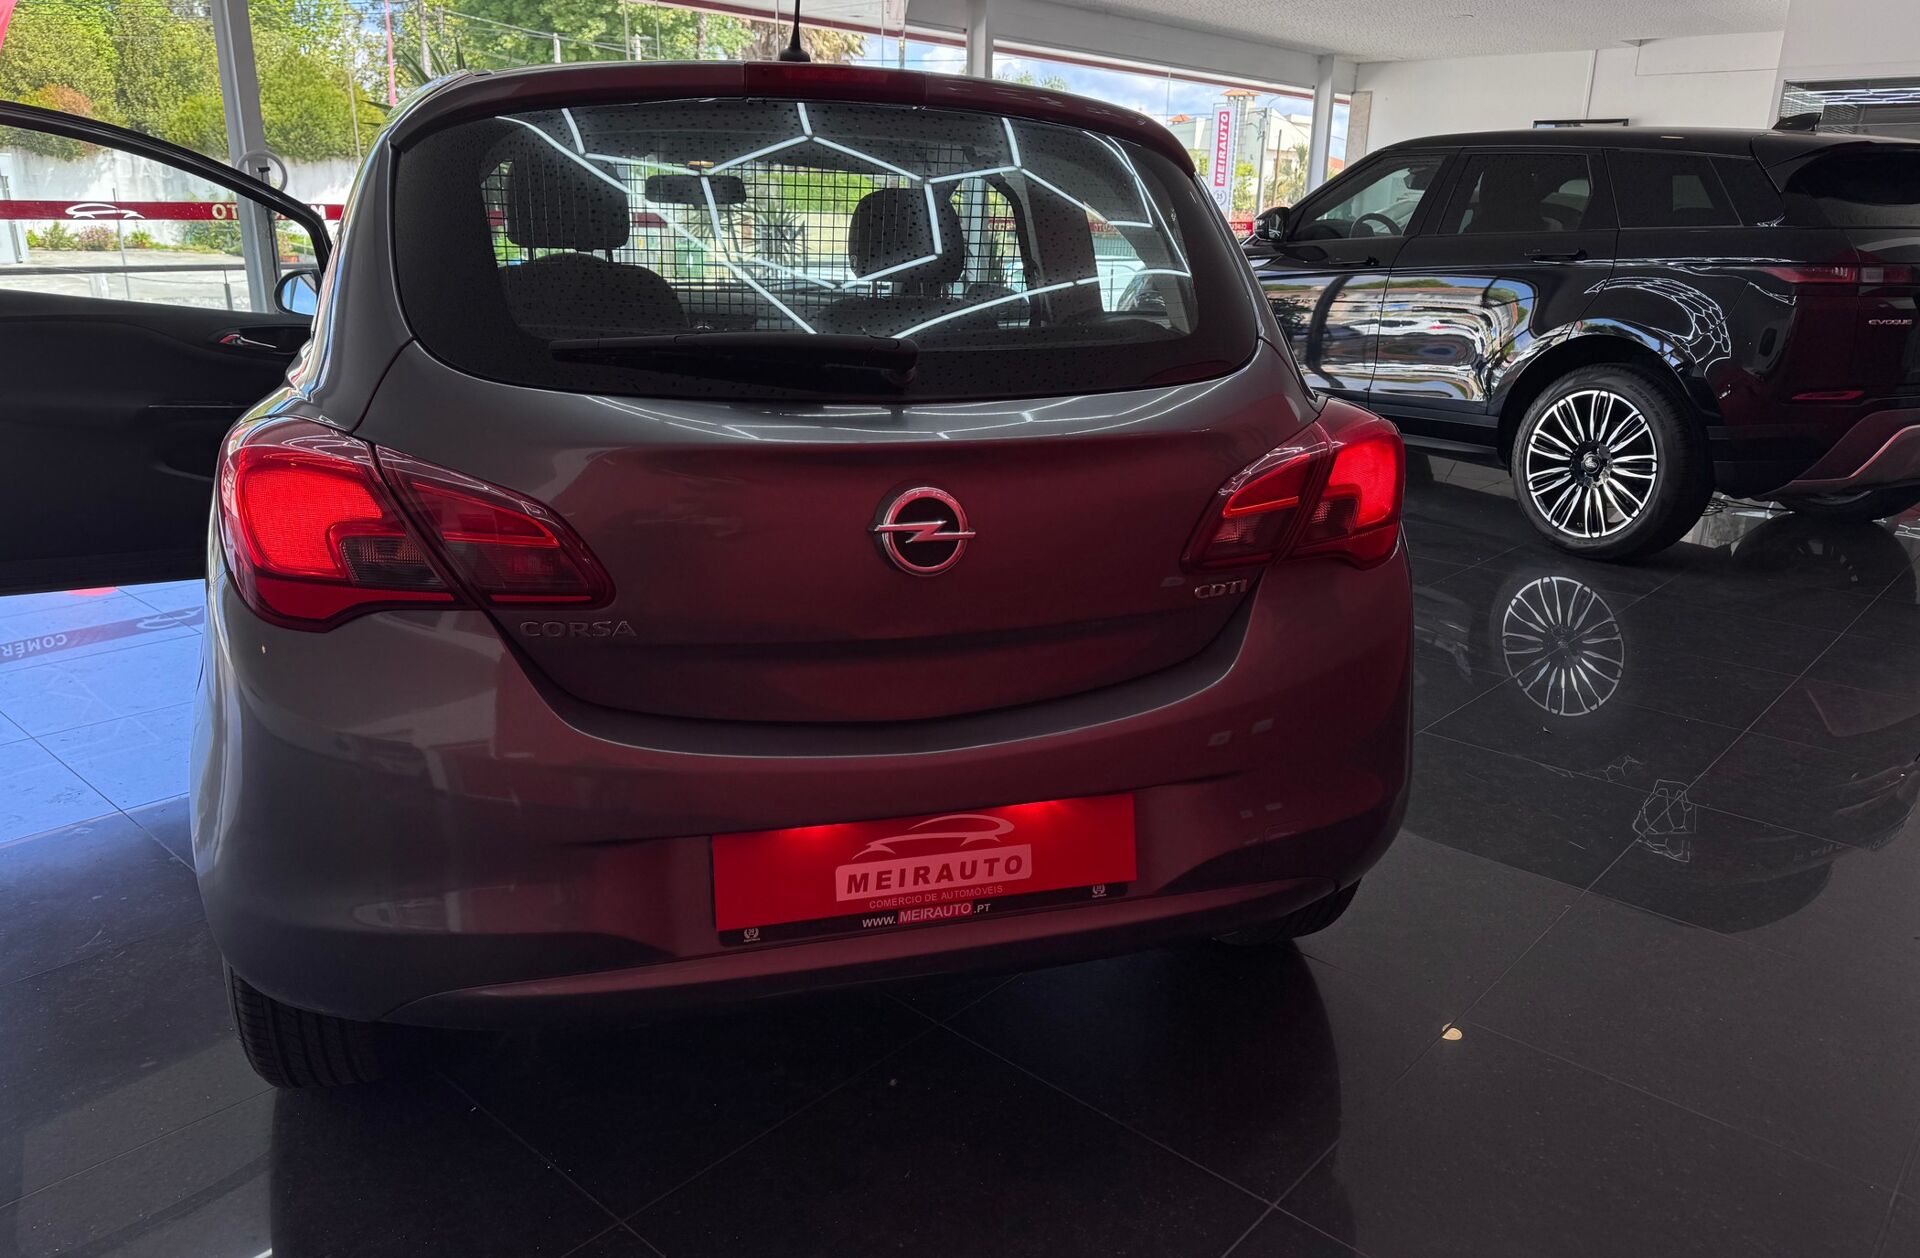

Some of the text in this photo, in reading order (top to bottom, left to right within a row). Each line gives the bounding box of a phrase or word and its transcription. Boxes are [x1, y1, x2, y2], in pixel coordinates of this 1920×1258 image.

[1216, 113, 1229, 185] MEIRAUTO
[519, 620, 638, 638] CORSA
[847, 855, 1022, 894] MEIRAUTO
[924, 892, 938, 902] DE
